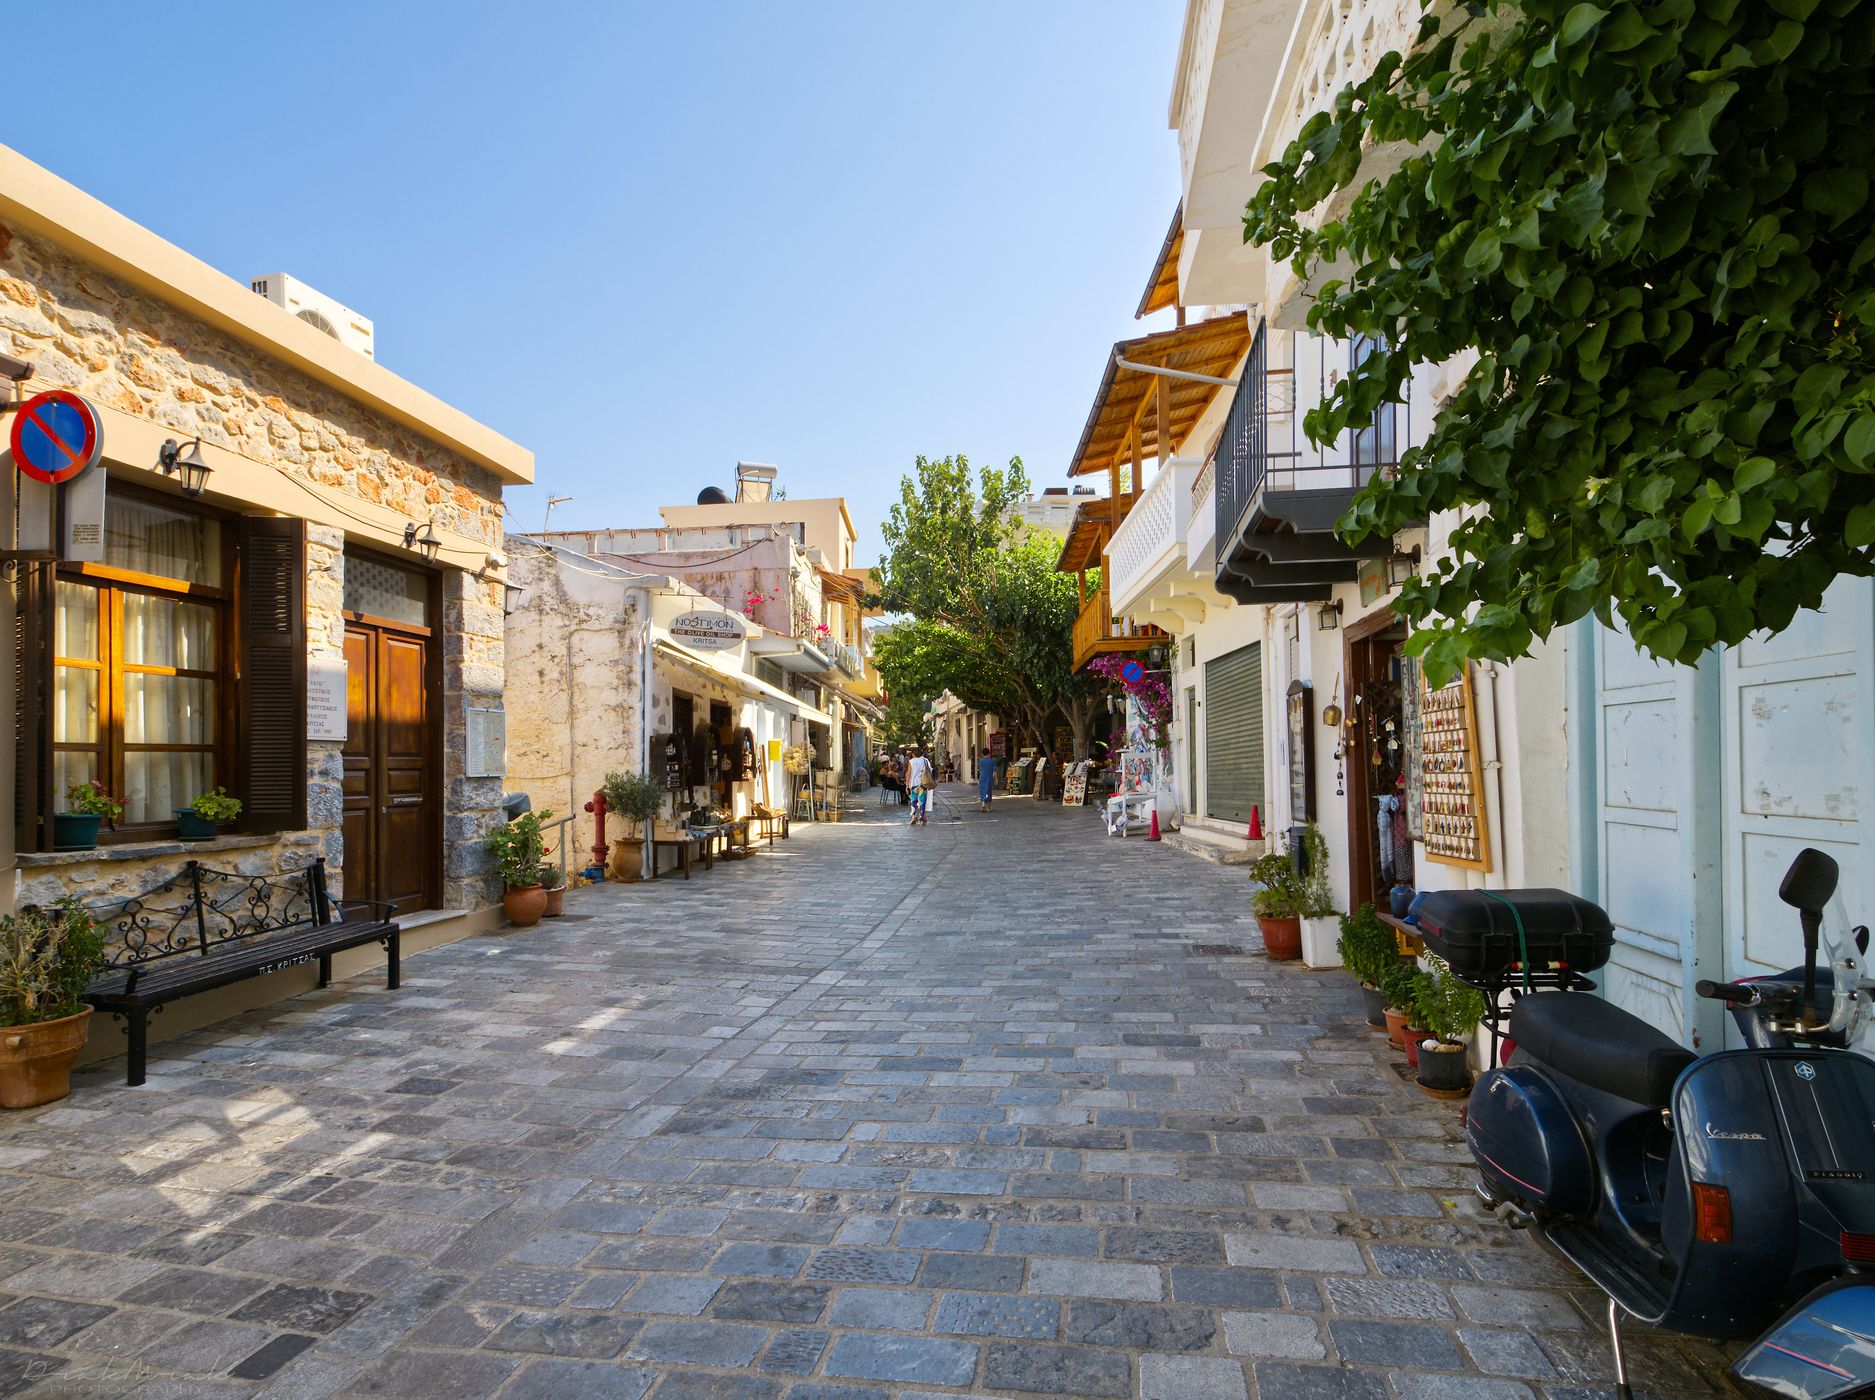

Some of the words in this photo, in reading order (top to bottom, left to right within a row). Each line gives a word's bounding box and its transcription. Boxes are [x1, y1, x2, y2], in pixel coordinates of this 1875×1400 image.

[675, 616, 734, 630] NOSTIMON
[692, 637, 717, 645] KRITSA
[277, 952, 316, 970] ΚΡΙΤΣΑΣ
[1705, 1121, 1768, 1140] Vespa
[1813, 1171, 1863, 1179] PIAGGIO
